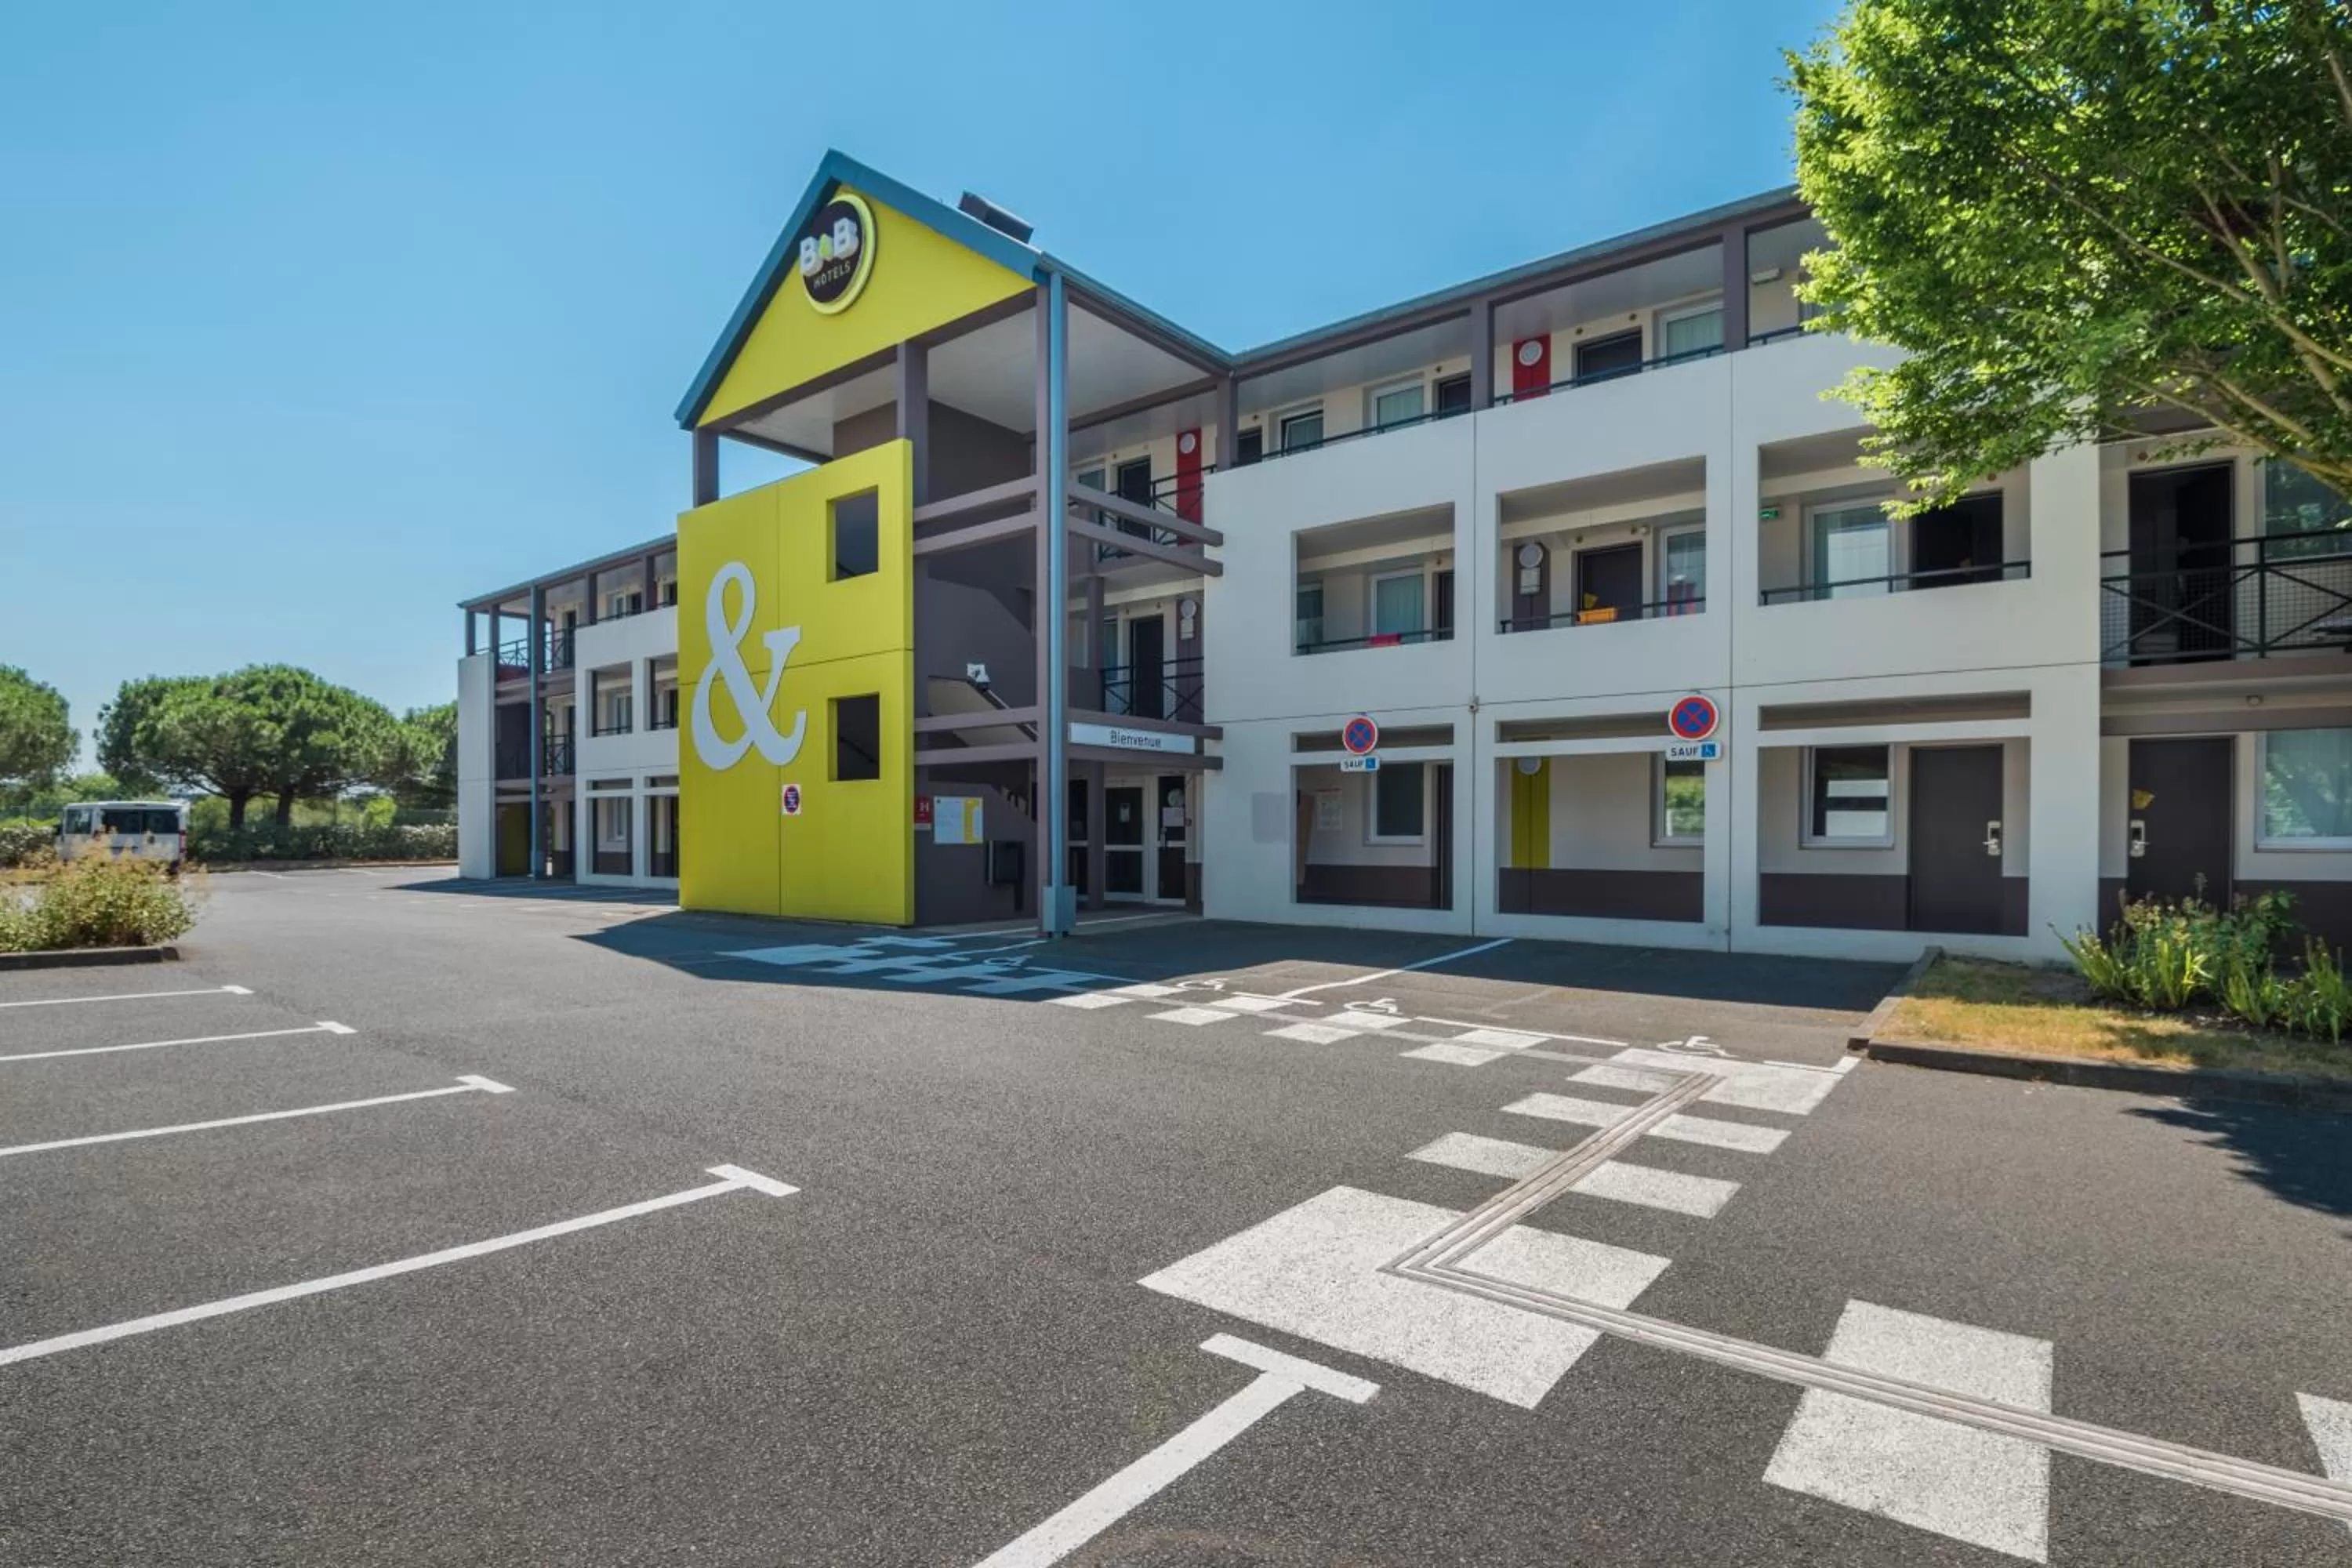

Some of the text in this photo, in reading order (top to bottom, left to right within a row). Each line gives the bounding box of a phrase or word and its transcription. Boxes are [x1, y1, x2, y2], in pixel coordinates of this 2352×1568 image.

[814, 260, 851, 289] HOTELS
[691, 561, 808, 771] &
[1110, 729, 1162, 749] Bienvenue
[1671, 746, 1699, 757] SAUF
[1343, 758, 1363, 769] SAUF
